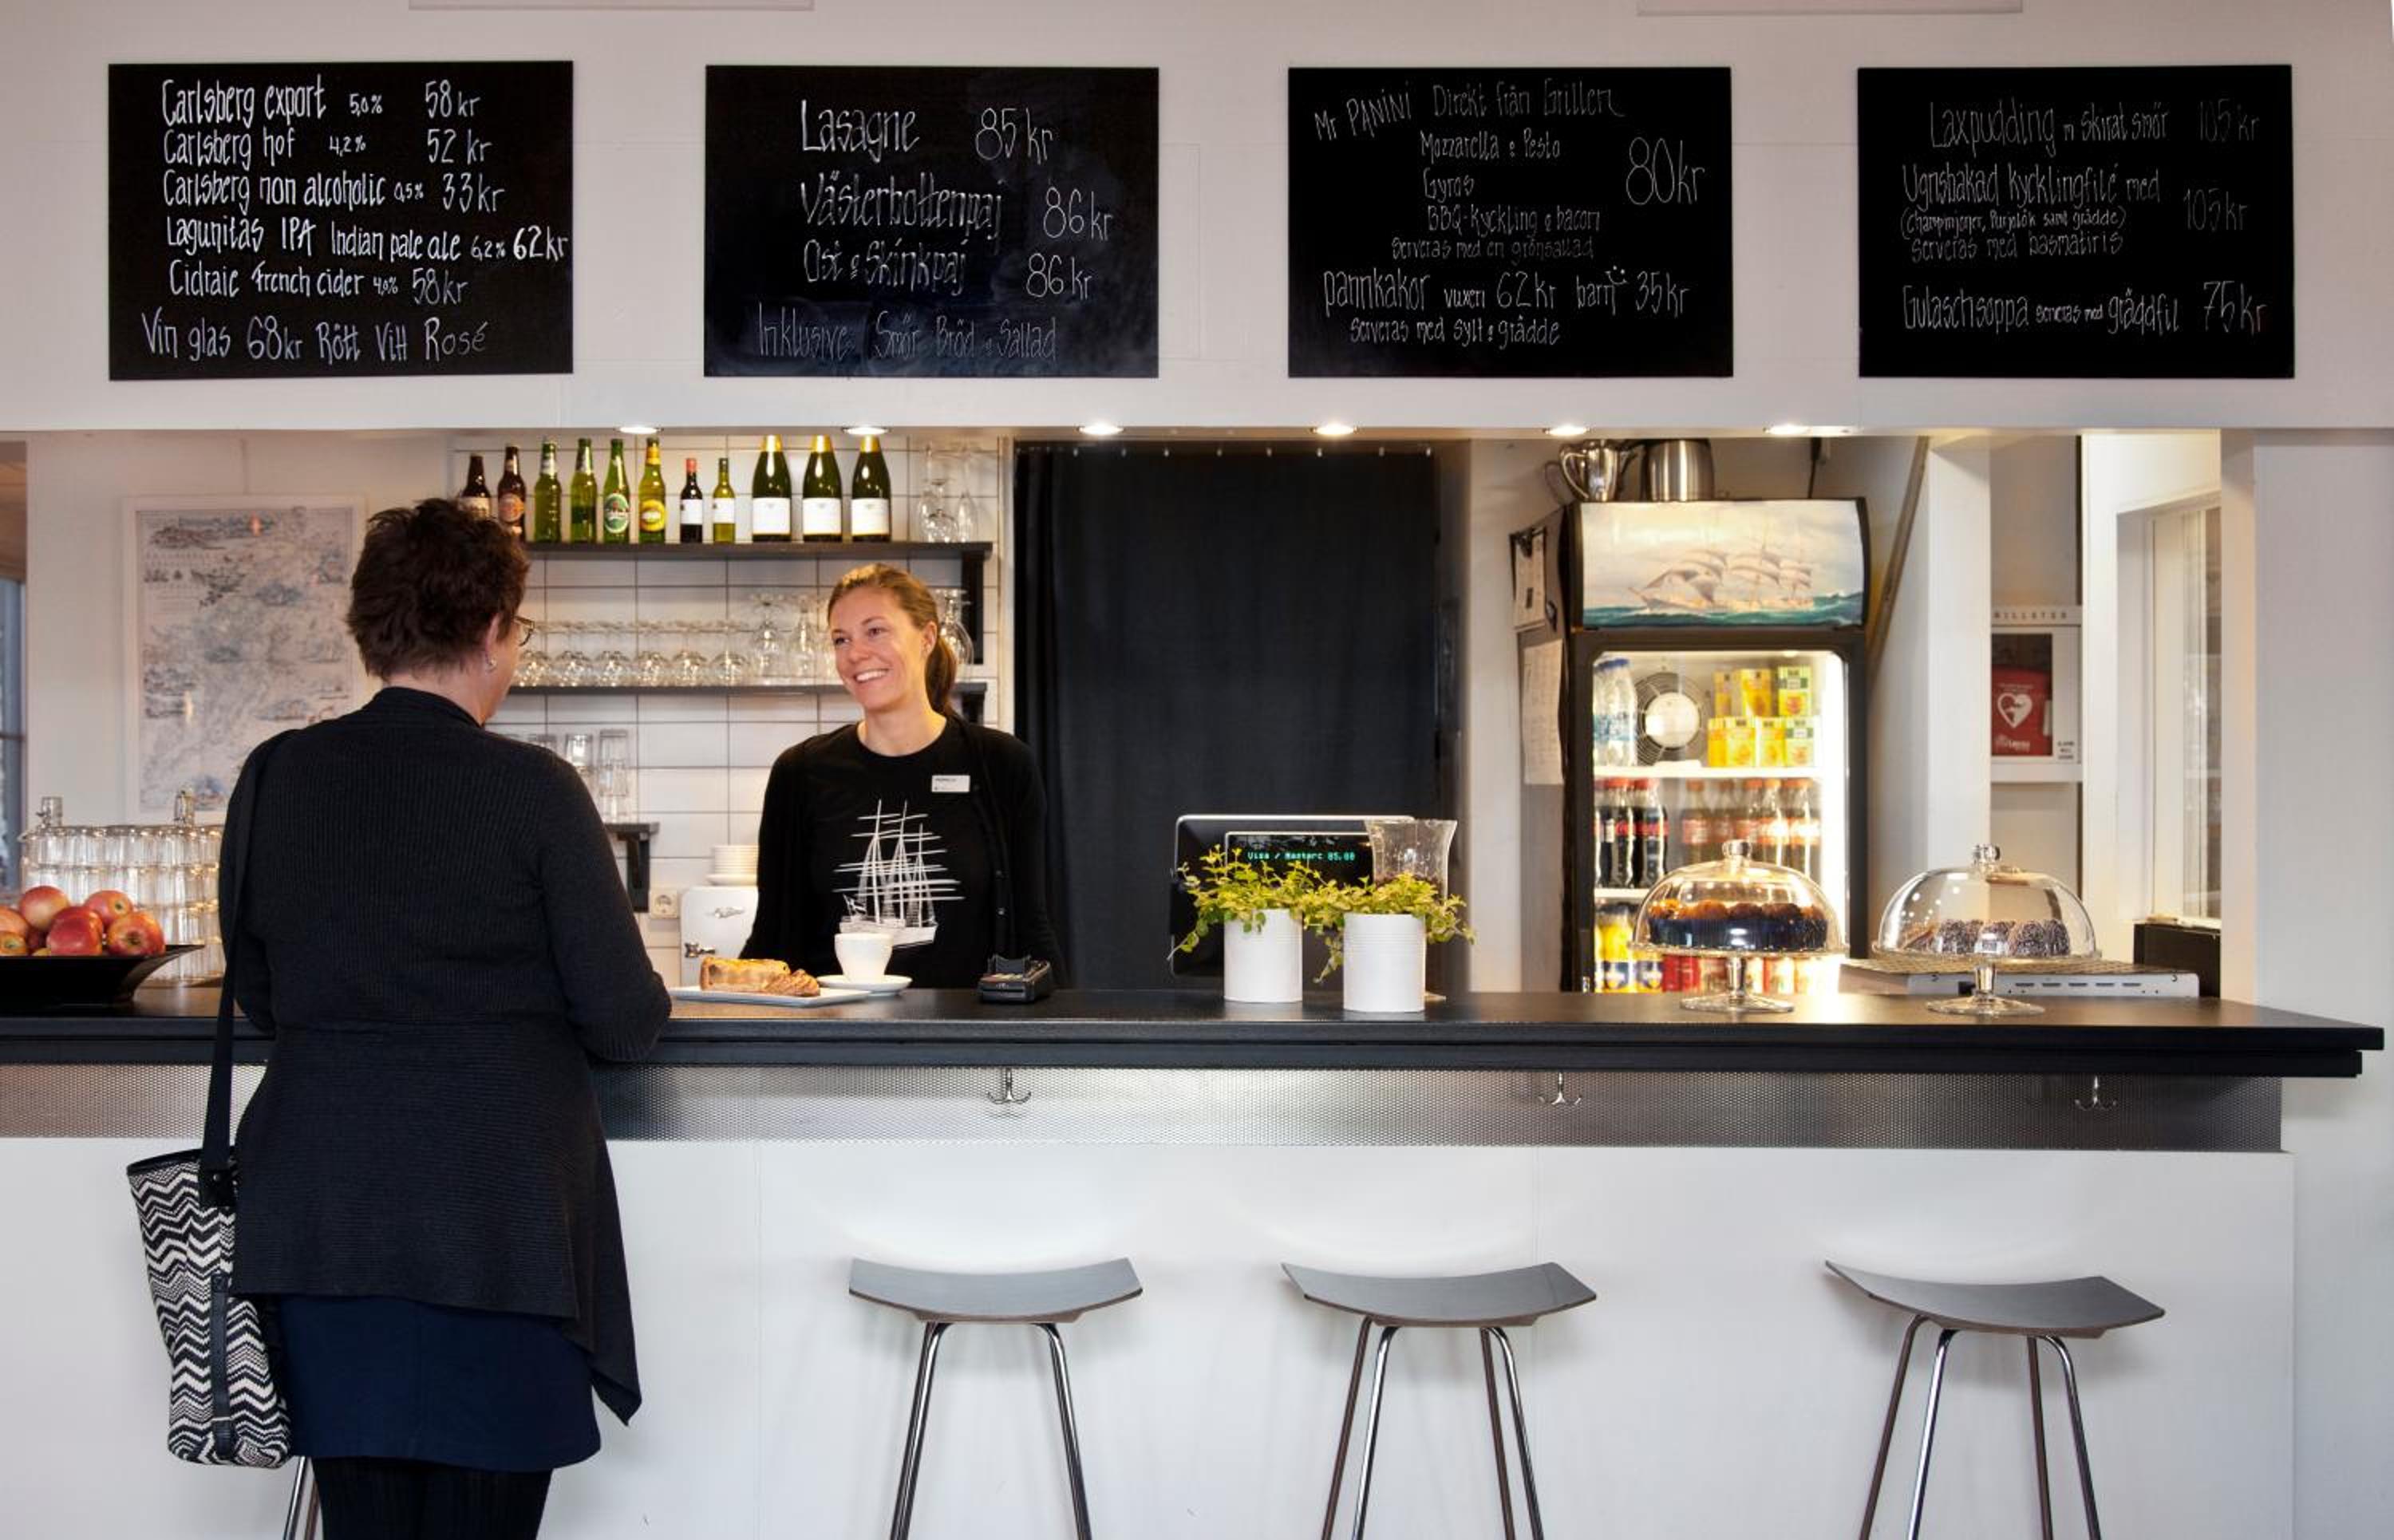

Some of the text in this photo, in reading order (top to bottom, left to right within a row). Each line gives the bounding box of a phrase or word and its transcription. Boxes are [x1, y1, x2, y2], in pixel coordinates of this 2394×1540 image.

[163, 79, 255, 128] Carlsberg
[265, 74, 326, 124] export
[1433, 82, 1487, 118] Direkt
[801, 99, 920, 163] Lasagne
[1314, 109, 1339, 141] Mr
[1420, 128, 1500, 164] Mozzarella
[1523, 127, 1561, 160] Pesto
[1929, 95, 2056, 159] Laxpudding
[164, 128, 251, 171] Carlsberg
[263, 126, 295, 164] hof
[164, 168, 250, 215] Carlsberg
[259, 176, 296, 206] non
[304, 170, 386, 211] alcoholic
[800, 169, 1008, 239] Västerbottenpaj
[1422, 167, 1475, 204] Gyros
[2126, 167, 2162, 203] med
[167, 215, 264, 256] Lagunitas
[282, 216, 317, 256] IPA
[331, 220, 384, 261] Indian
[390, 229, 424, 263] pale
[428, 231, 462, 261] ale
[804, 239, 843, 282] Ost
[317, 267, 364, 297] cider
[1574, 274, 1617, 317] barn
[141, 307, 178, 357] Vin
[188, 317, 231, 361] glas
[425, 316, 488, 361] Rosé
